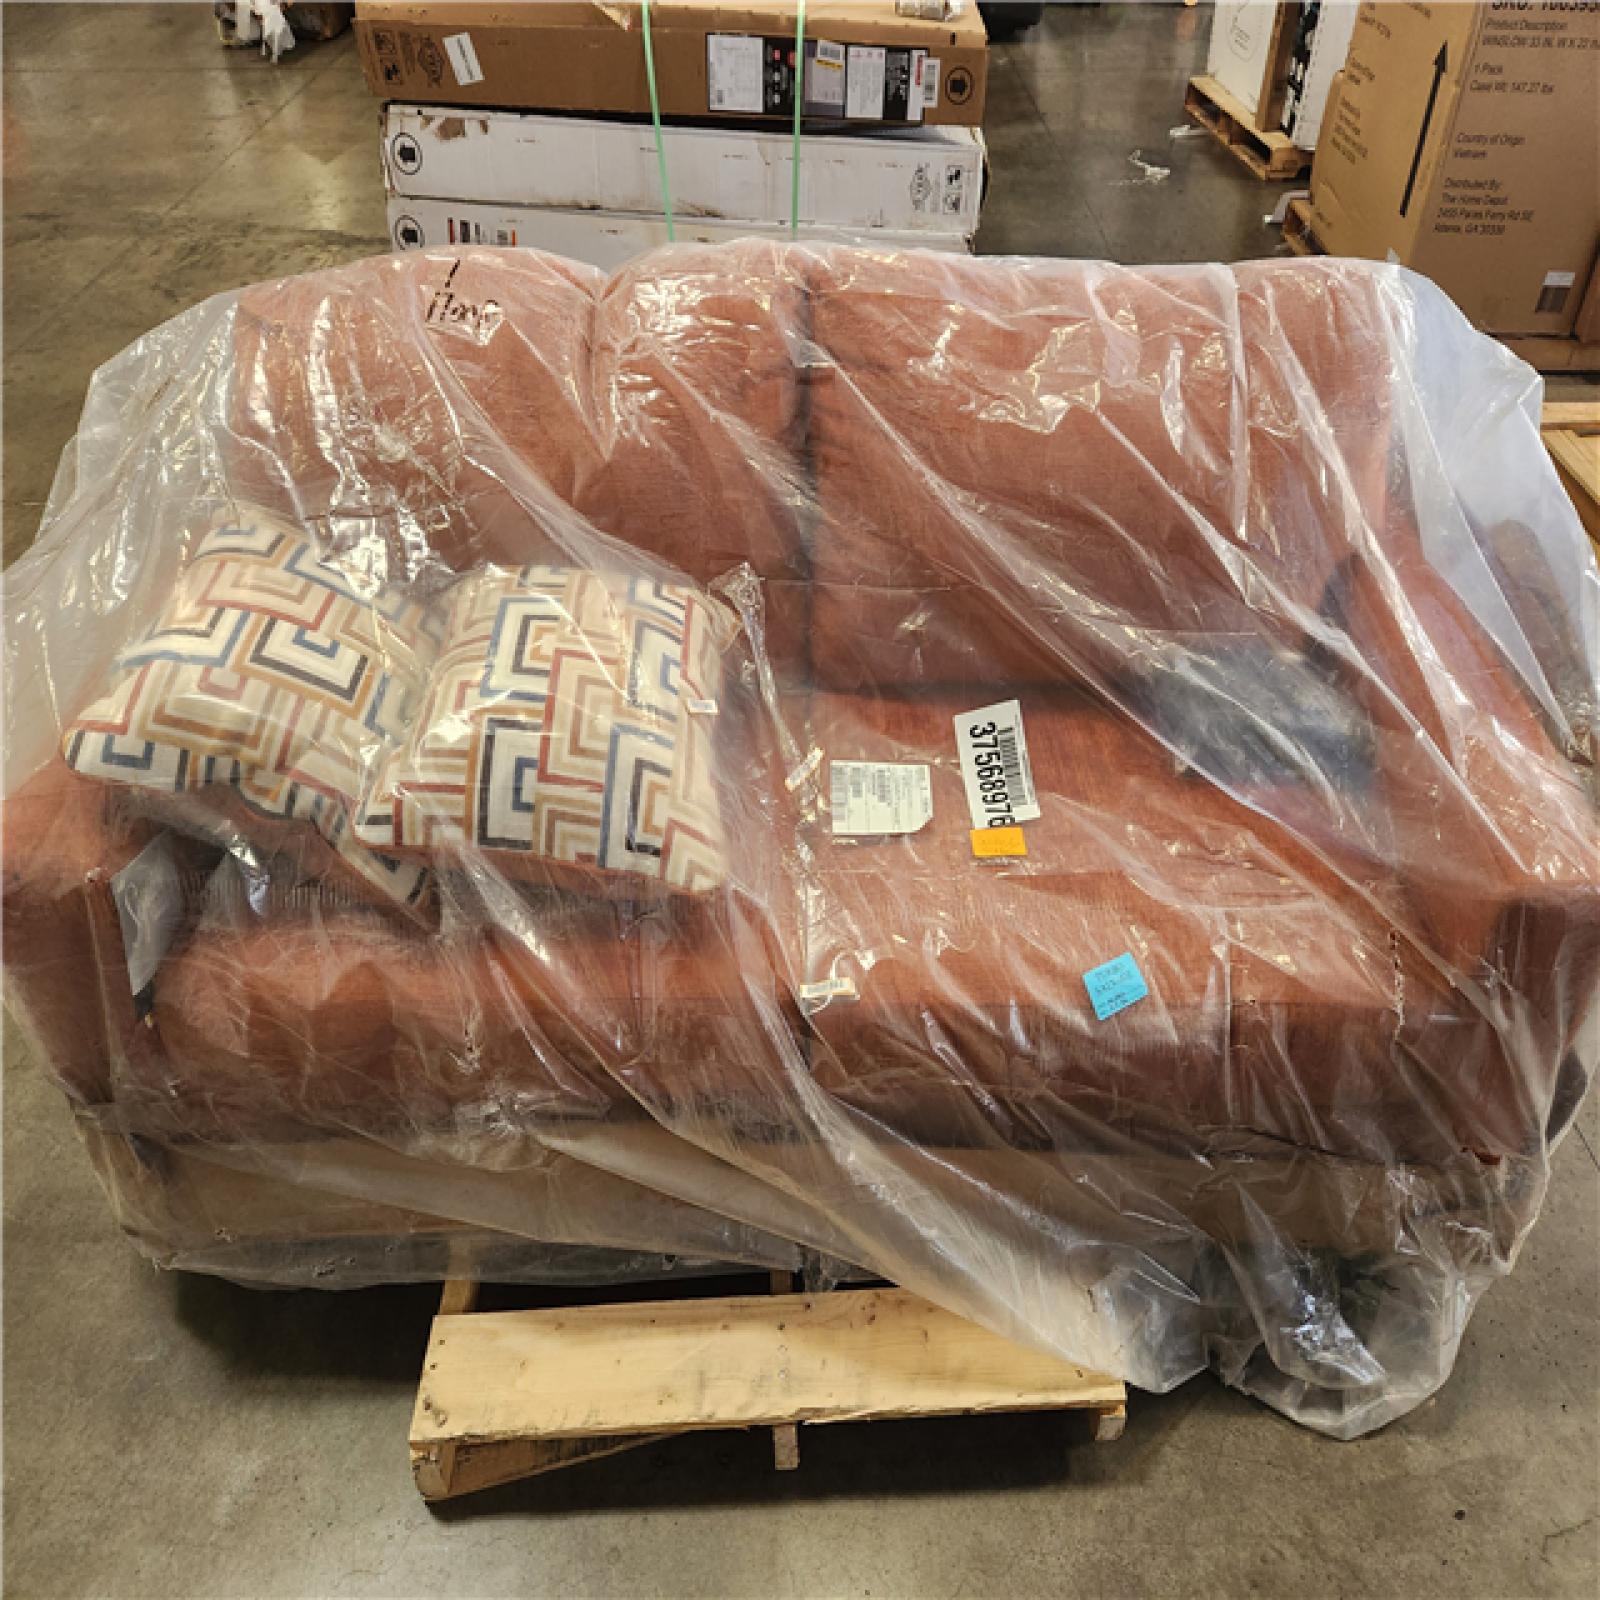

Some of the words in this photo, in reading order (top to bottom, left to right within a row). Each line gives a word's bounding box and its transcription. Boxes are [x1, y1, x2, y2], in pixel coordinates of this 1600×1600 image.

[1484, 18, 1518, 30] Product
[1520, 18, 1568, 32] Description
[1482, 63, 1503, 75] Pack
[1457, 132, 1488, 145] Country
[1489, 133, 1499, 145] of
[1500, 133, 1525, 147] Origin
[1454, 150, 1488, 159] Vietnam
[1442, 192, 1456, 203] The
[1458, 194, 1481, 205] Home
[1482, 194, 1508, 206] Depot
